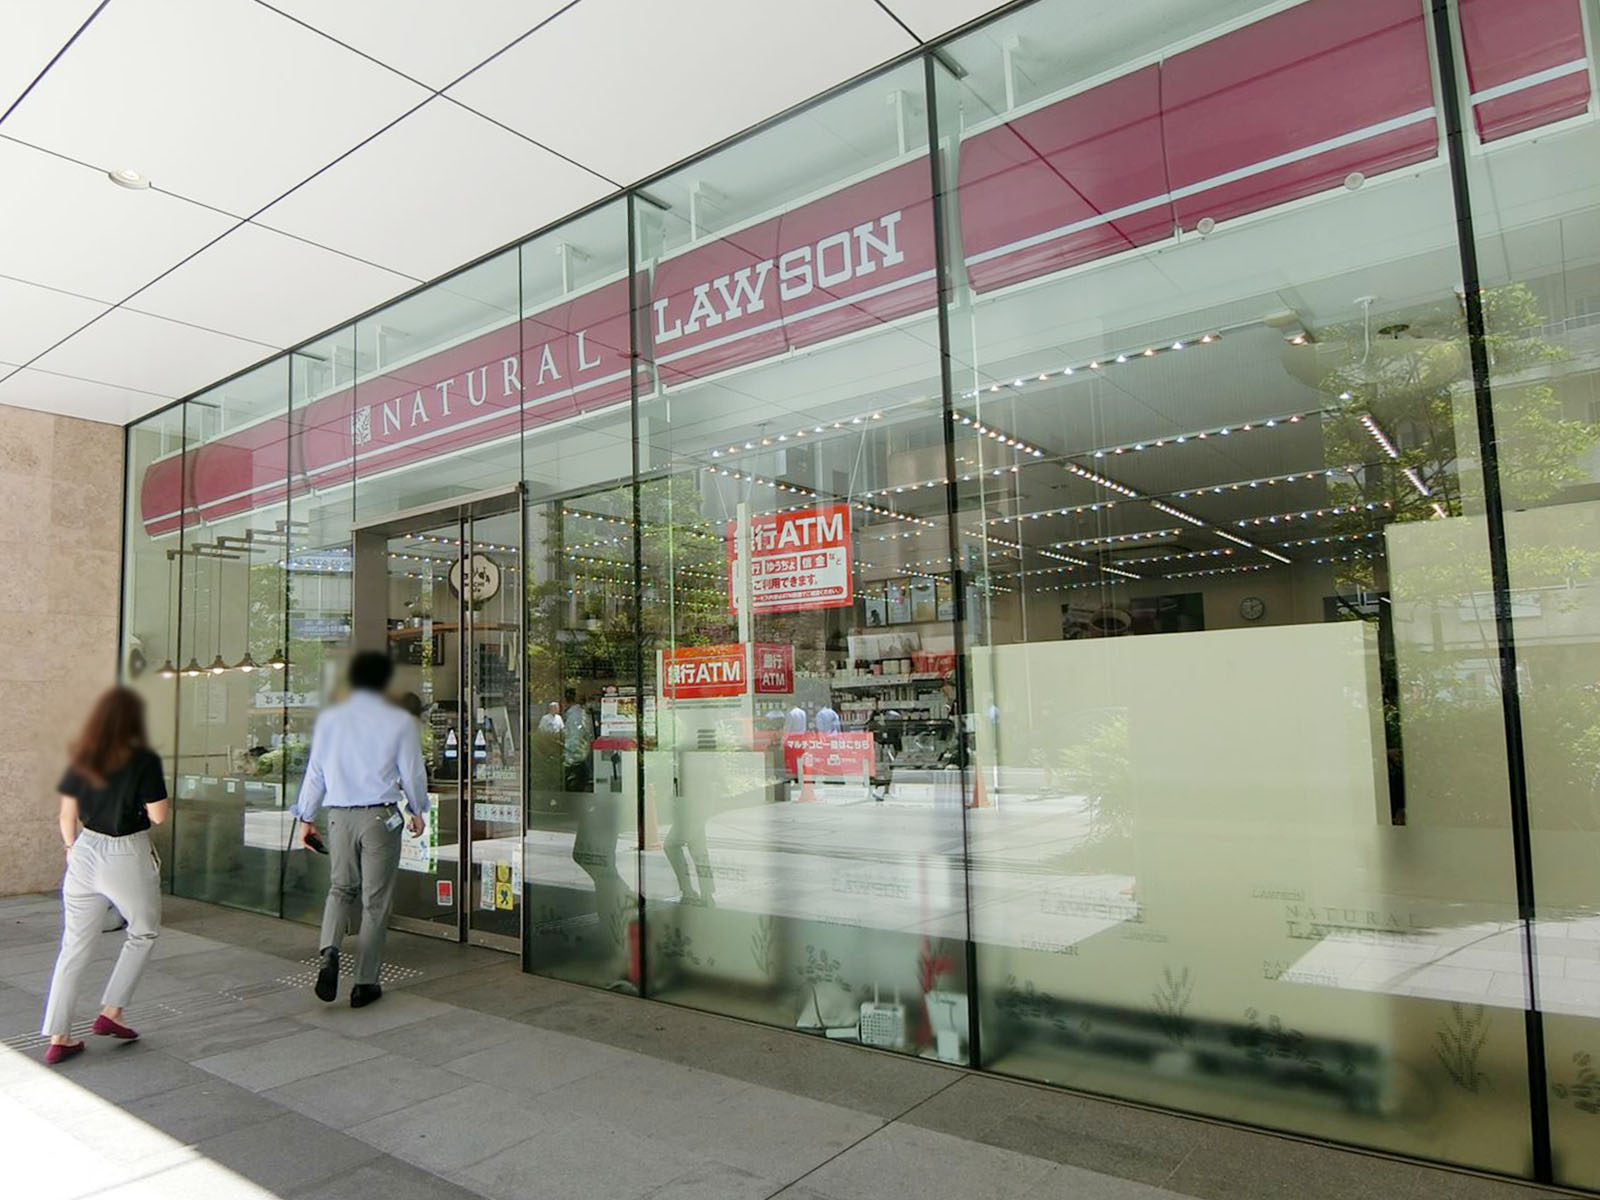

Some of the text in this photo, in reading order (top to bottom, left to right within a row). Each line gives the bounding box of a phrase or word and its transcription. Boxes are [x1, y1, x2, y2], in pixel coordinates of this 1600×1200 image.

[381, 211, 905, 436] NATURAL LAWSON
[734, 513, 843, 553] 行ATM
[668, 660, 741, 685] 銀行ATM
[762, 672, 785, 687] ATM
[1285, 904, 1424, 928] NATURAL
